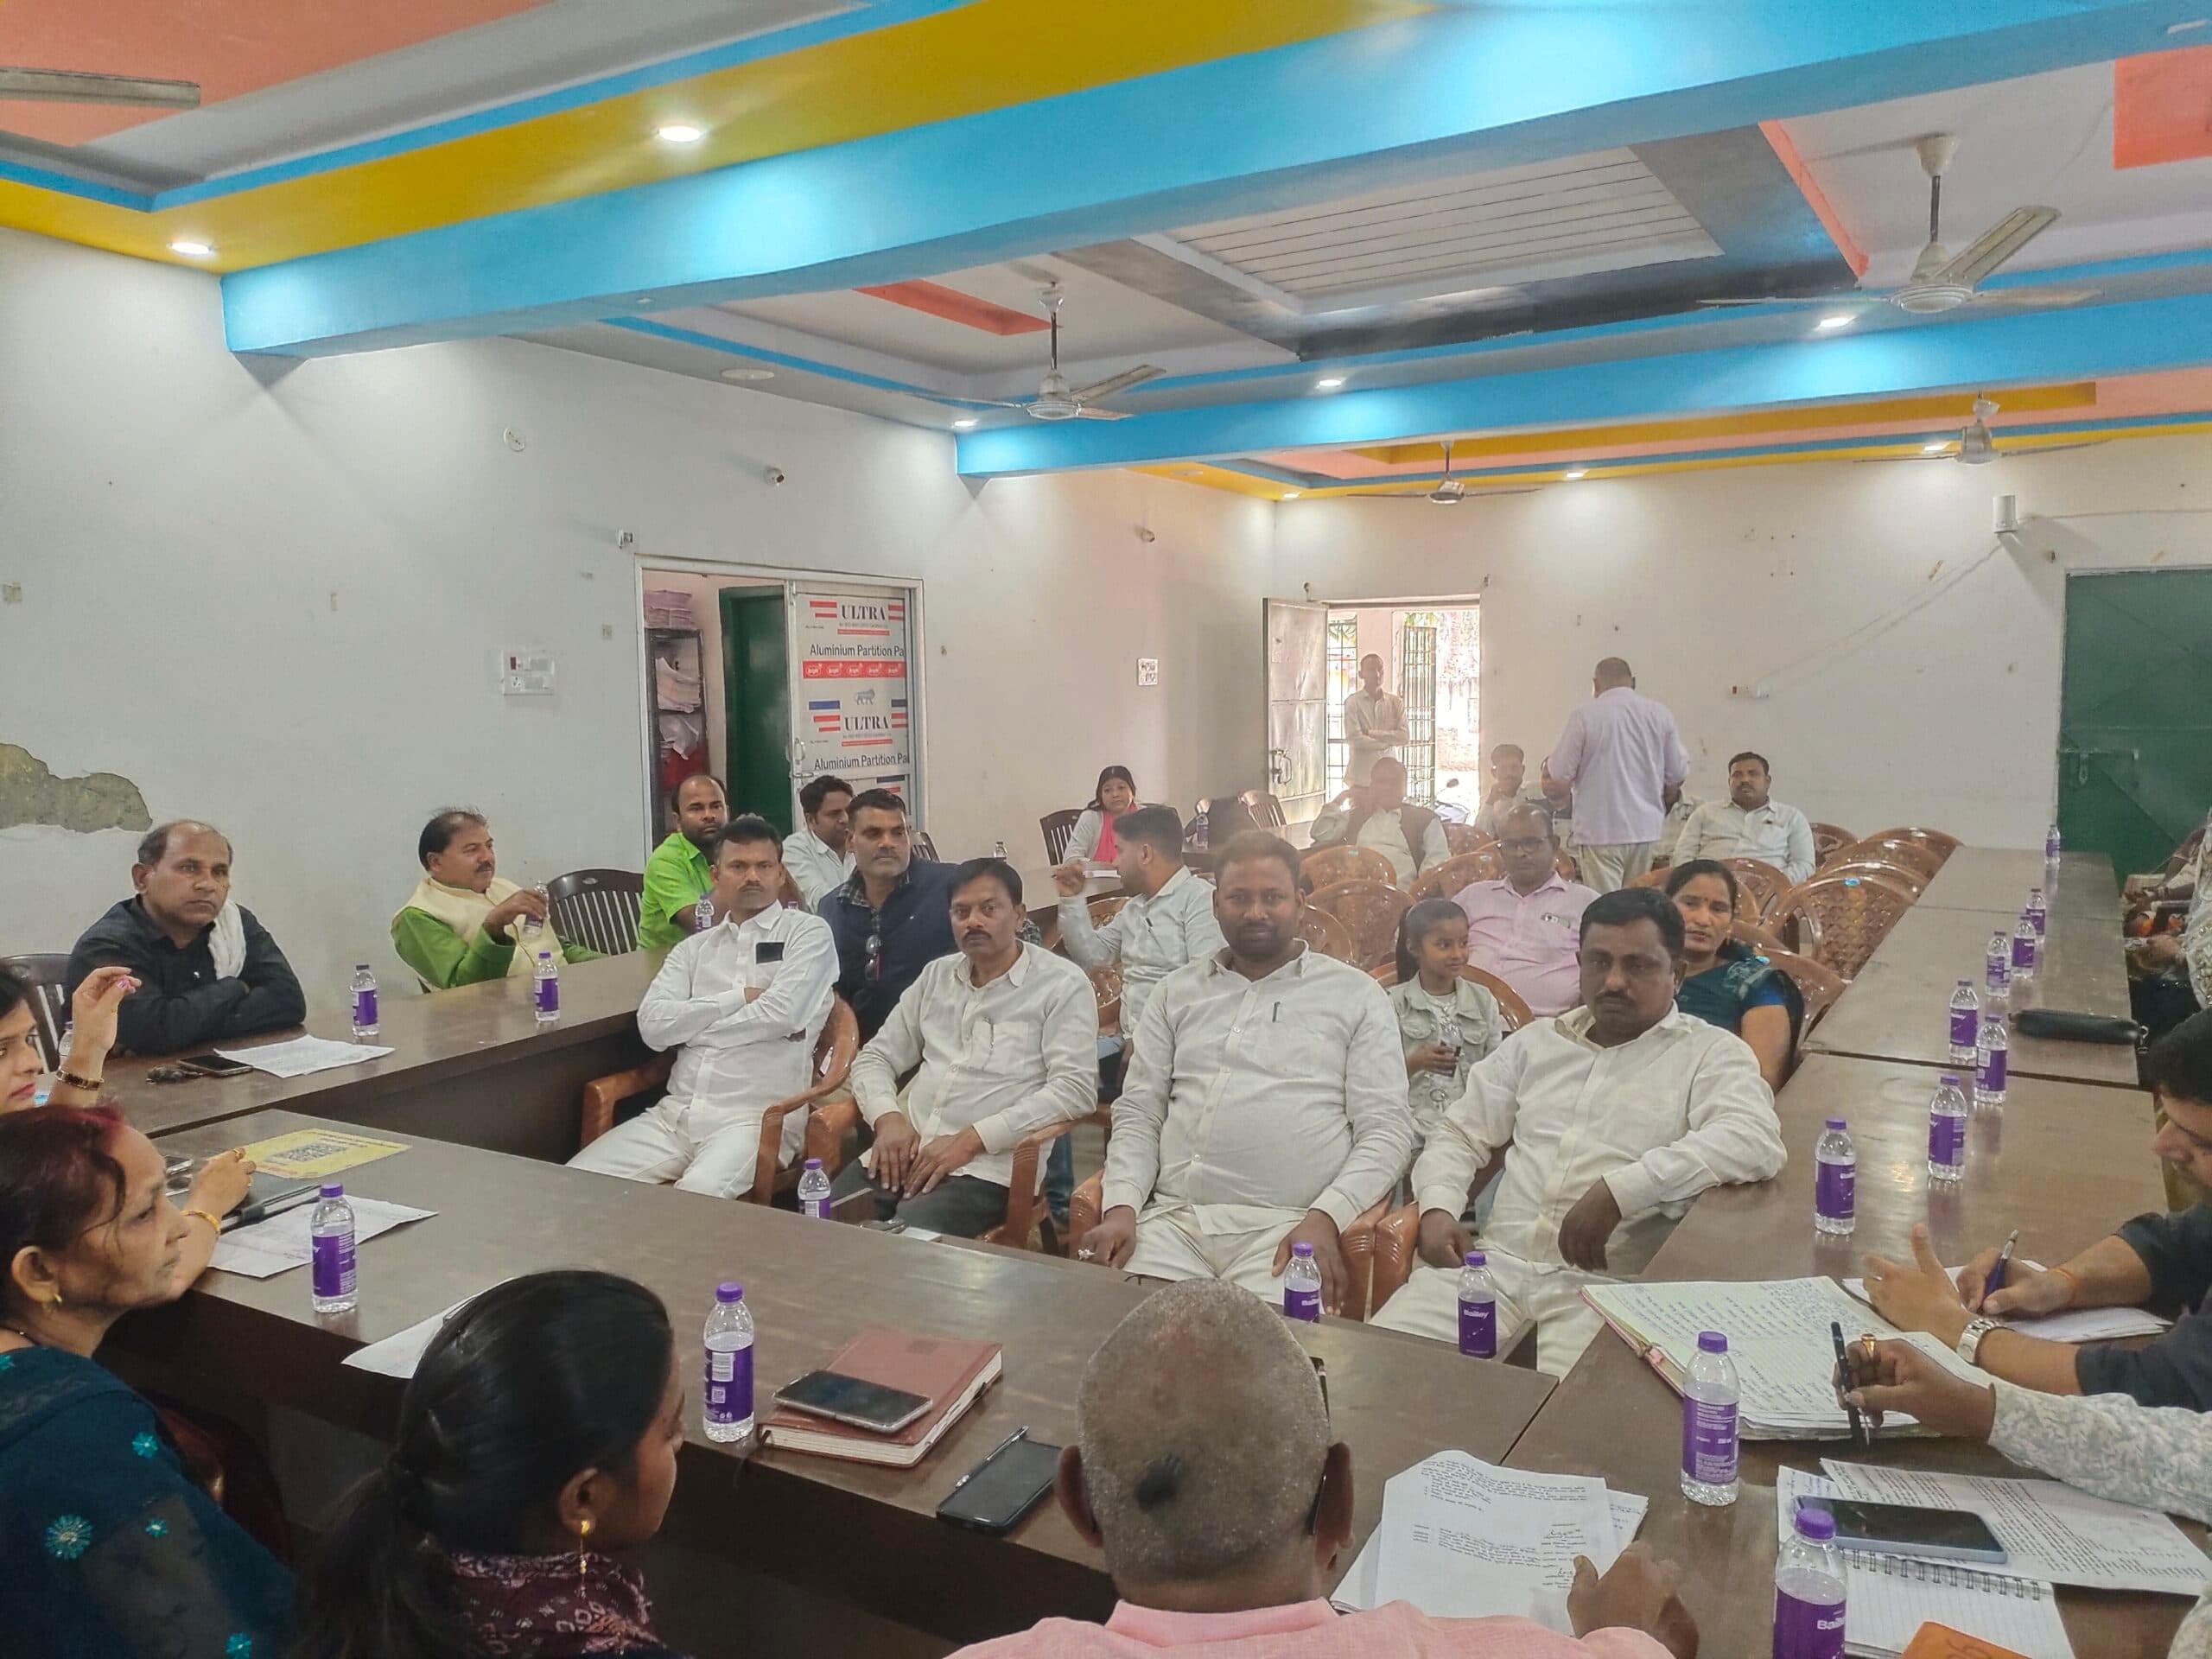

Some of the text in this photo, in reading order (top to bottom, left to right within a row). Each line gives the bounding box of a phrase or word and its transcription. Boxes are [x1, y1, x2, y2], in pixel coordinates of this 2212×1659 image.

[841, 604, 886, 620] ULTRA
[810, 644, 855, 656] Aluminium
[857, 645, 892, 657] Partition
[844, 715, 889, 731] ULTRA
[814, 756, 859, 771] Aluminium
[861, 753, 896, 767] Partition
